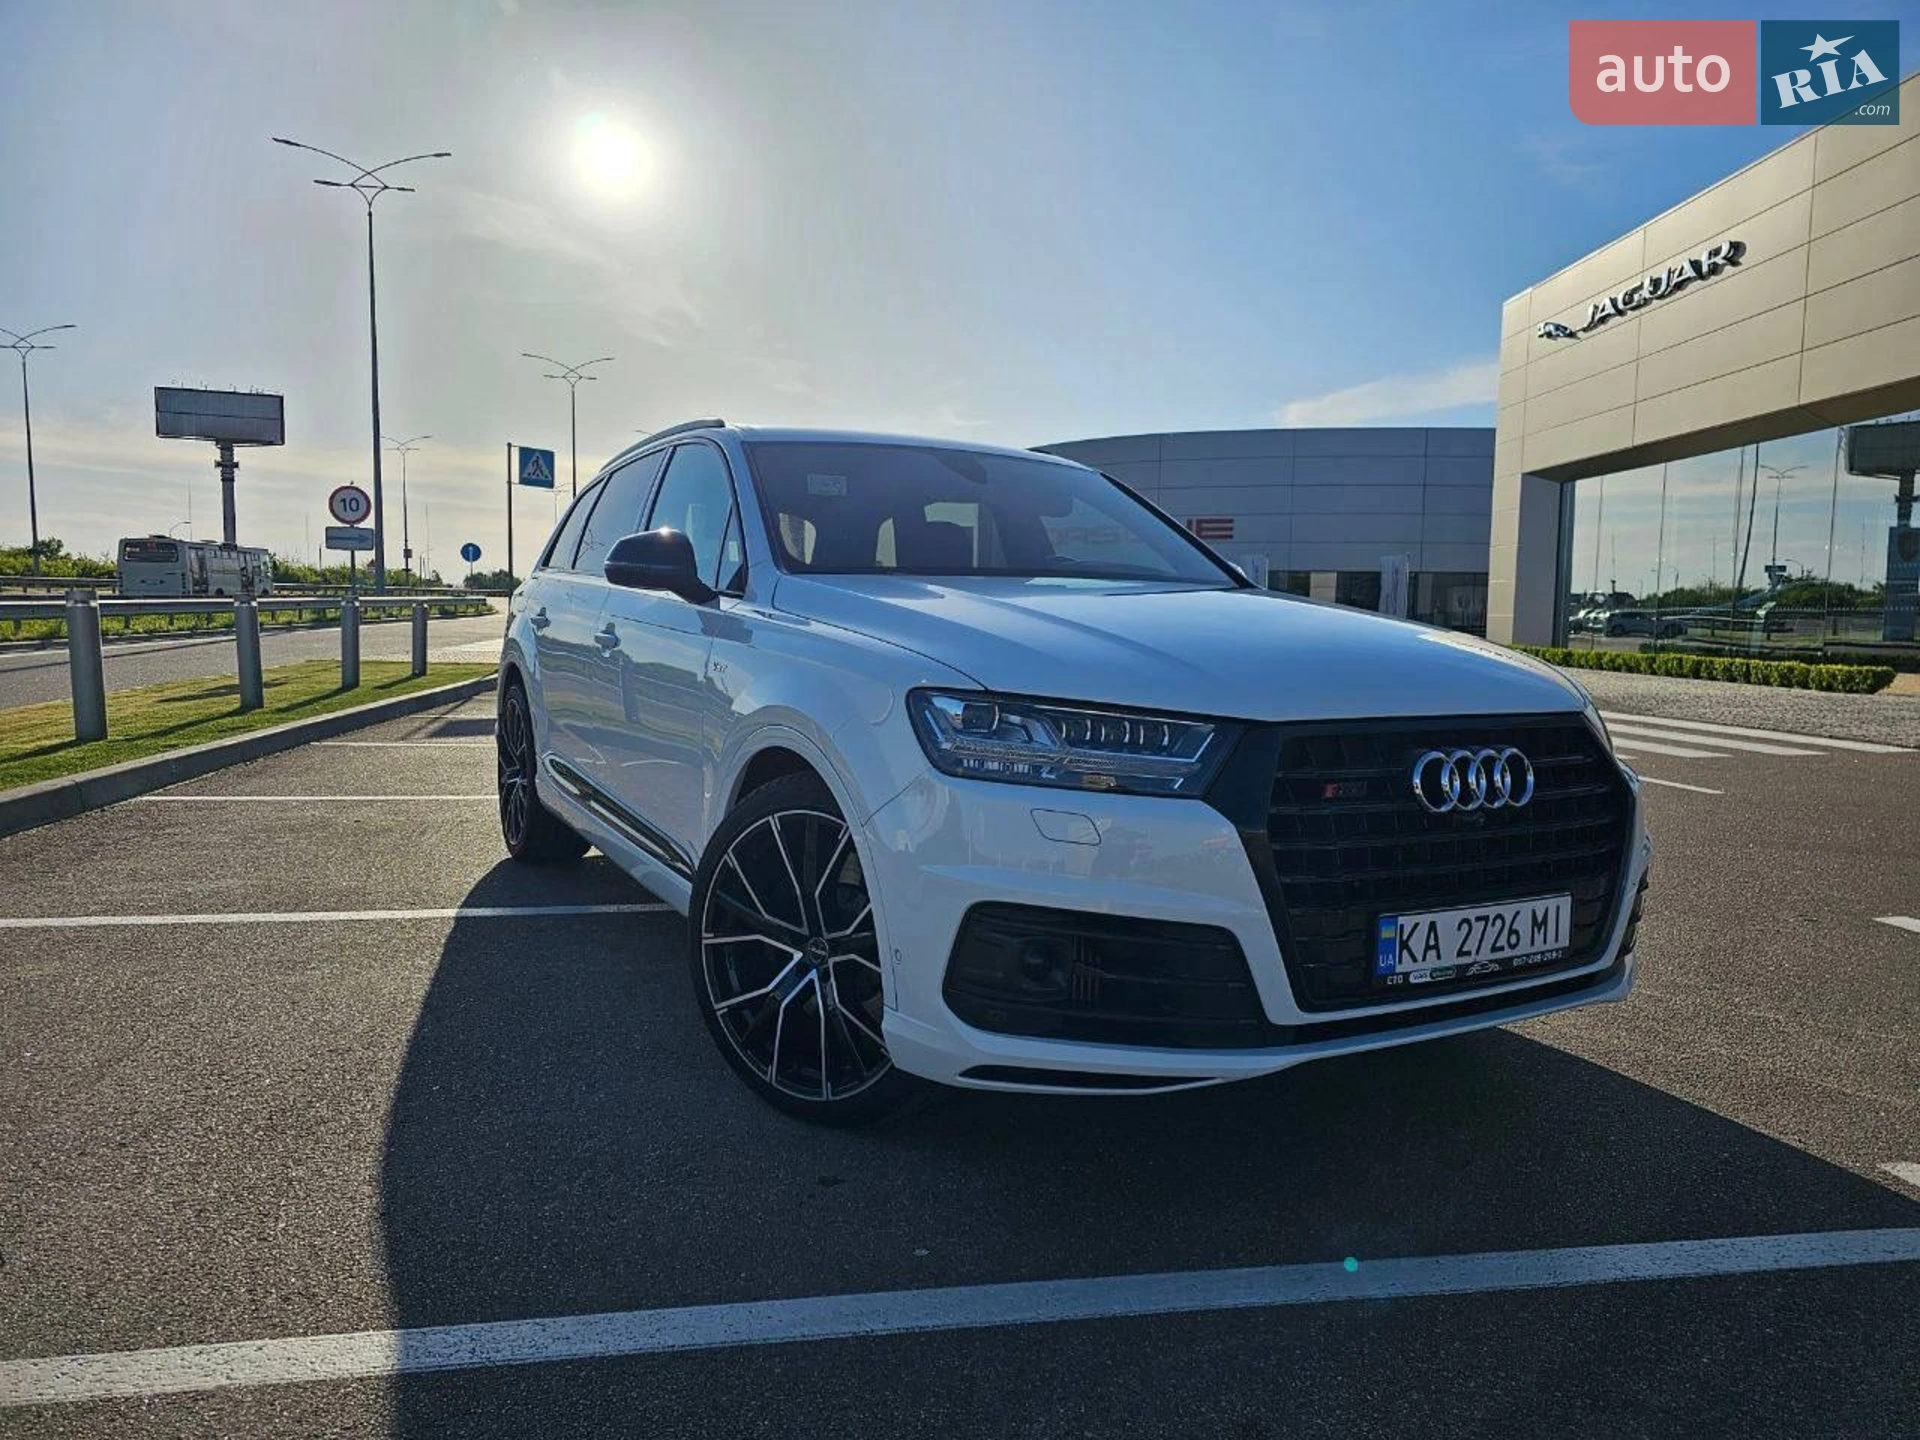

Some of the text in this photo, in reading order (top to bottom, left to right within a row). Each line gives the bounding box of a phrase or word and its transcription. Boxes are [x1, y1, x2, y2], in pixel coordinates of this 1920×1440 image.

[1586, 240, 1737, 329] JAGUAR
[339, 497, 360, 513] 10
[1397, 904, 1562, 966] KA 2726 MI
[1379, 952, 1394, 967] UA
